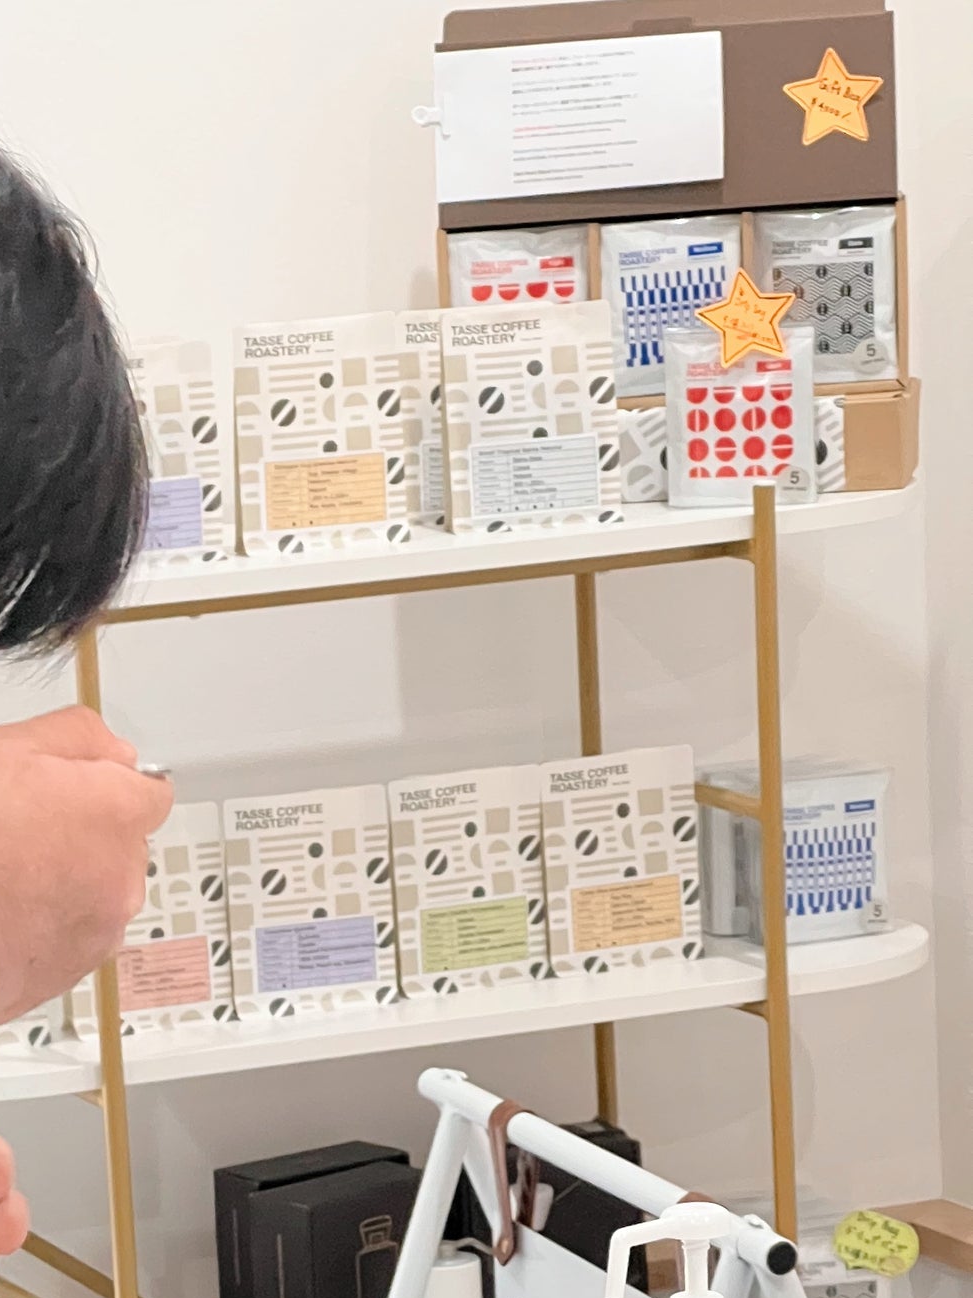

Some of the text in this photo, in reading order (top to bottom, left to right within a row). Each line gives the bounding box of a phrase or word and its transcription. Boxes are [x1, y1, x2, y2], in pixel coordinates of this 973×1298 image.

[406, 321, 440, 333] TASSE
[451, 318, 542, 336] TASSE COFFEE
[244, 330, 334, 347] TASSE COFFEE
[451, 333, 516, 347] ROASTERY
[244, 345, 311, 359] ROASTERY
[866, 343, 876, 357] 5
[789, 471, 800, 484] 5
[550, 763, 629, 783] TASSE COFFEE
[399, 782, 477, 802] TASSE COFFEE
[550, 777, 608, 793] ROASTERY
[235, 803, 323, 820] TASSE COFFEE
[400, 796, 457, 812] ROASTERY
[235, 816, 300, 832] ROASTERY
[873, 904, 883, 917] 5
